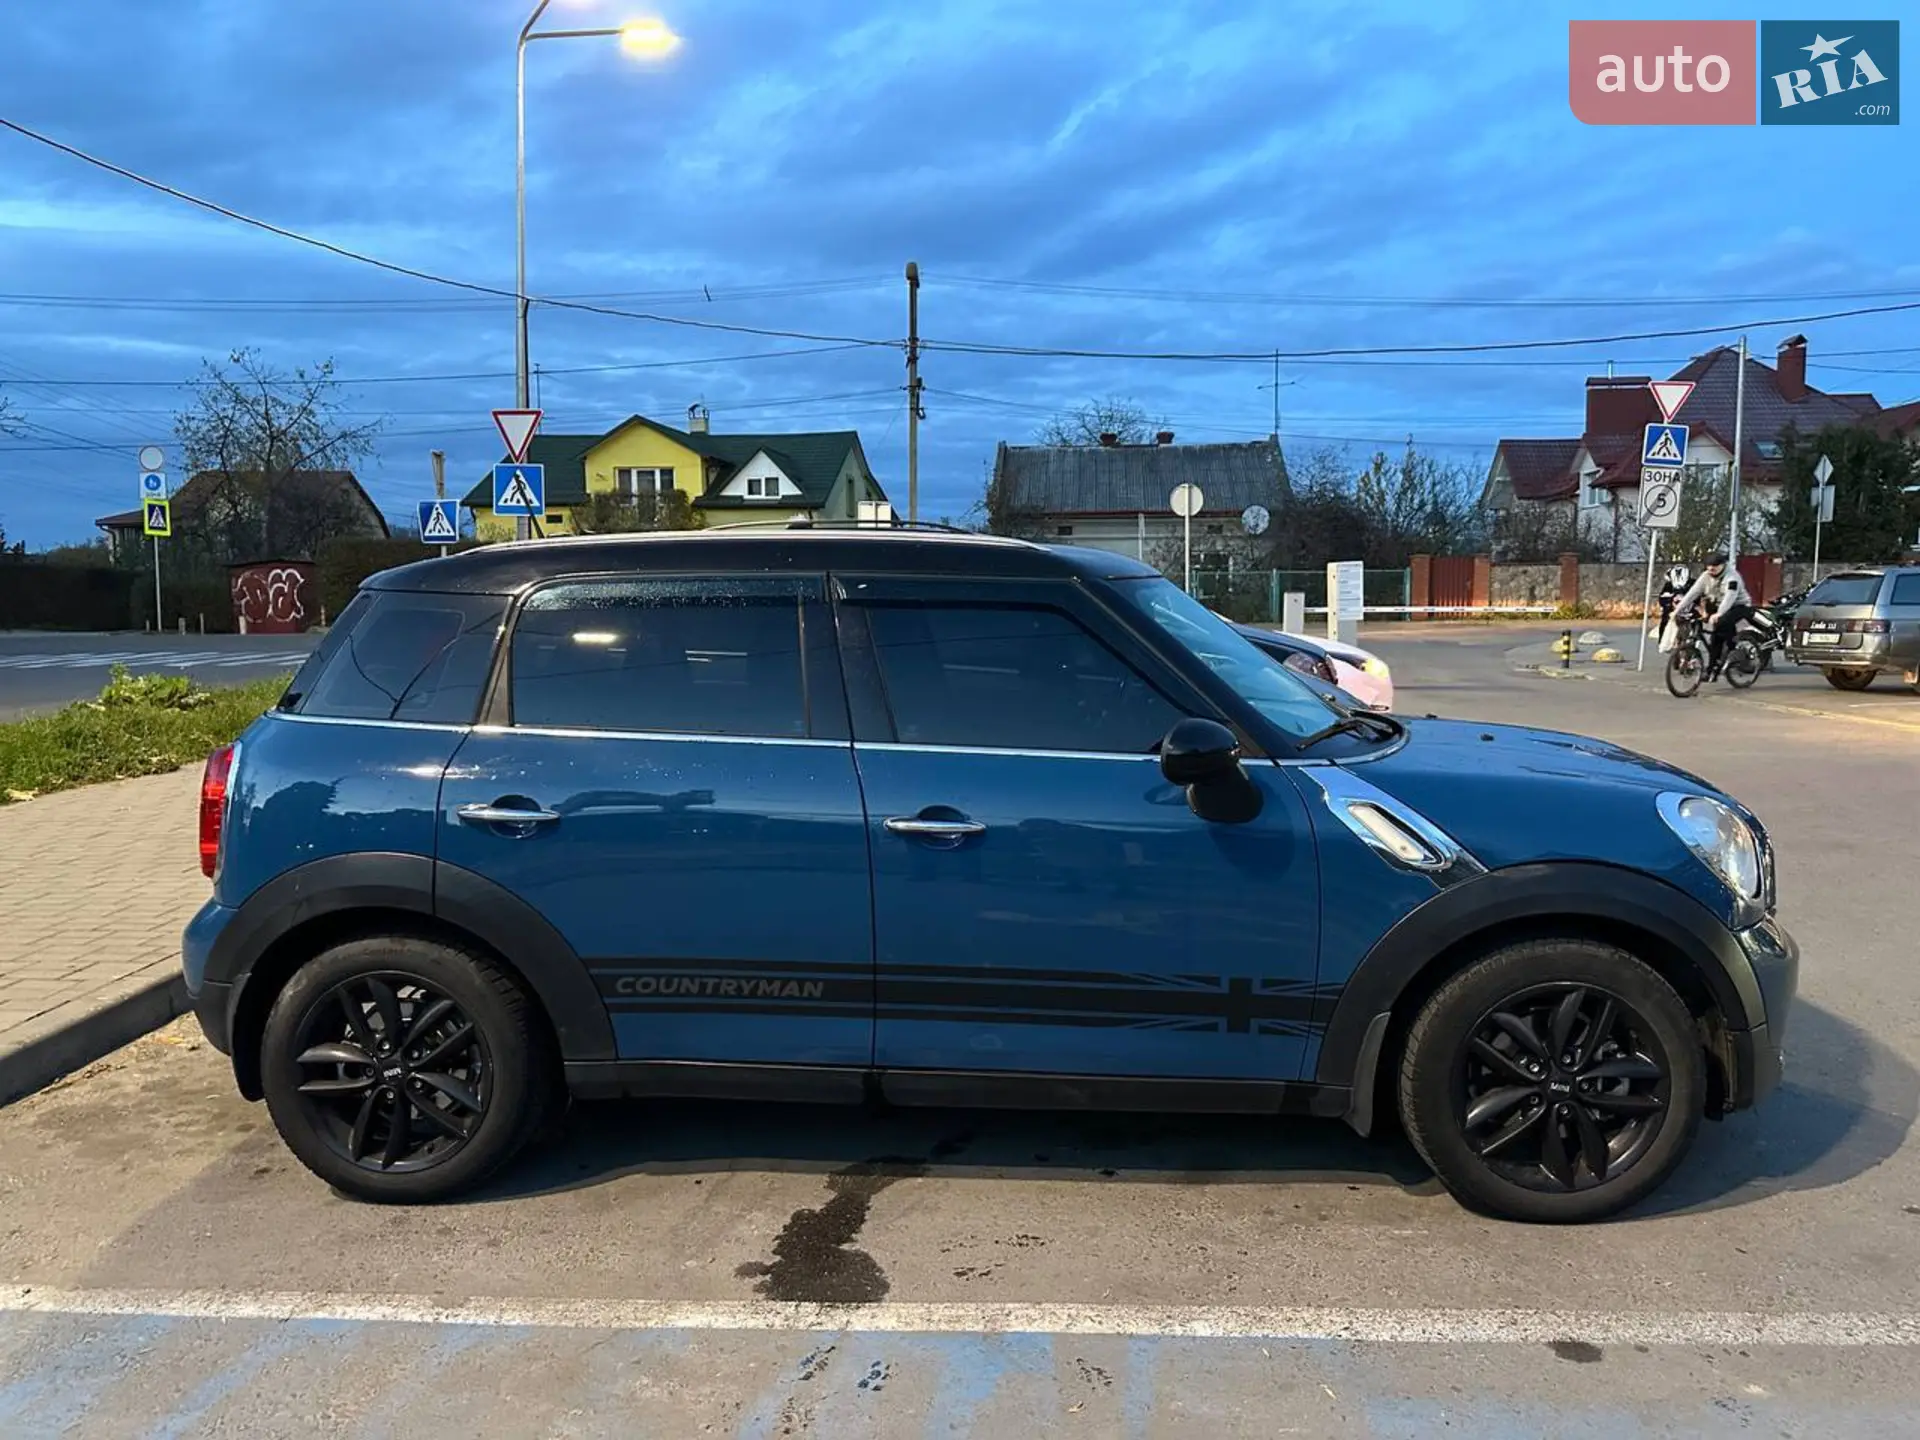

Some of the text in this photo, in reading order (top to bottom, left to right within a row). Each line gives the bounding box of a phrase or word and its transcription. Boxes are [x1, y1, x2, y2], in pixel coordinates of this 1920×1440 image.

[1644, 470, 1681, 483] ЗОНА
[1657, 493, 1667, 508] 5
[615, 975, 824, 999] COUNTRYMAN
